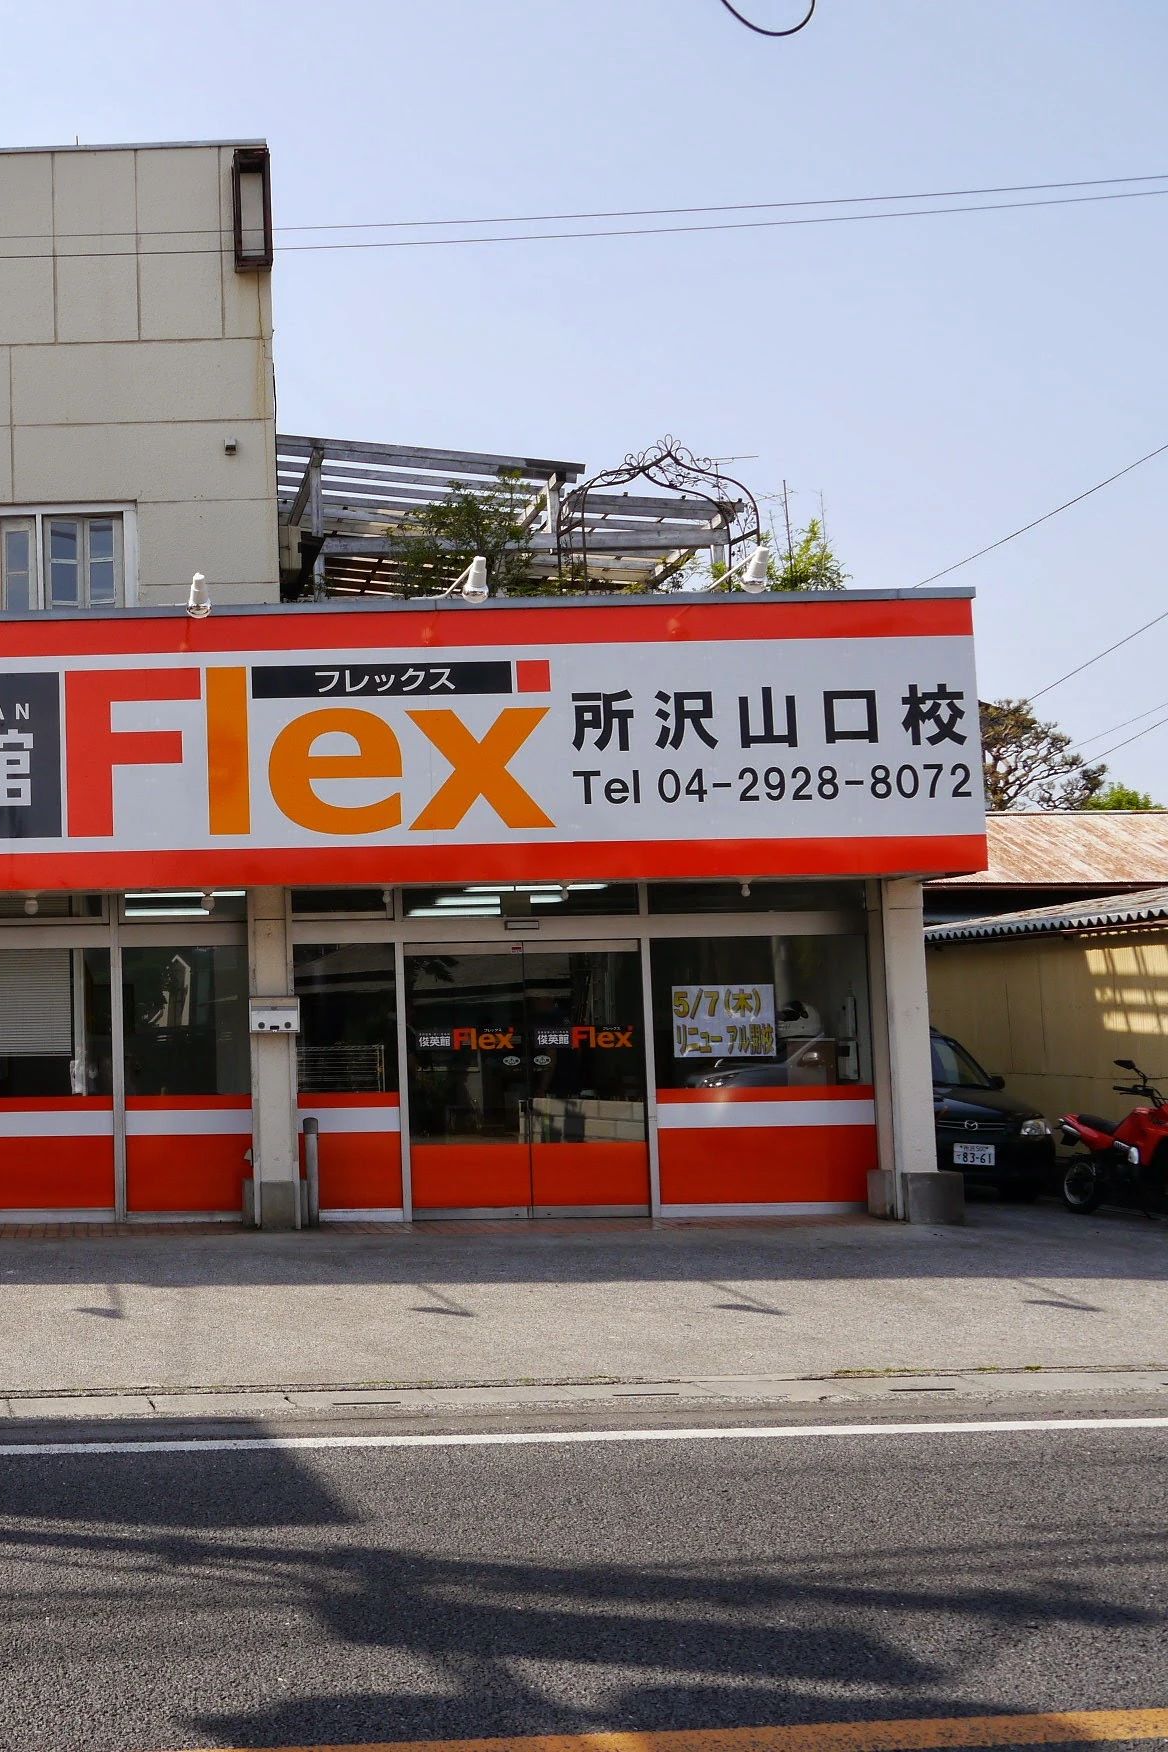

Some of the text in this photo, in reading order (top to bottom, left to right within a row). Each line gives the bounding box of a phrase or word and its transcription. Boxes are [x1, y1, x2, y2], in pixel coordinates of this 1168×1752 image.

[314, 667, 457, 693] フレックス
[571, 683, 968, 752] 所沢山口校
[64, 666, 557, 837] Flex
[572, 763, 972, 805] Tel 04-2928-8072
[419, 1036, 451, 1047] 俊英館
[452, 1027, 515, 1050] Flex
[537, 1034, 570, 1045] 俊英館
[571, 1026, 633, 1049] Flex
